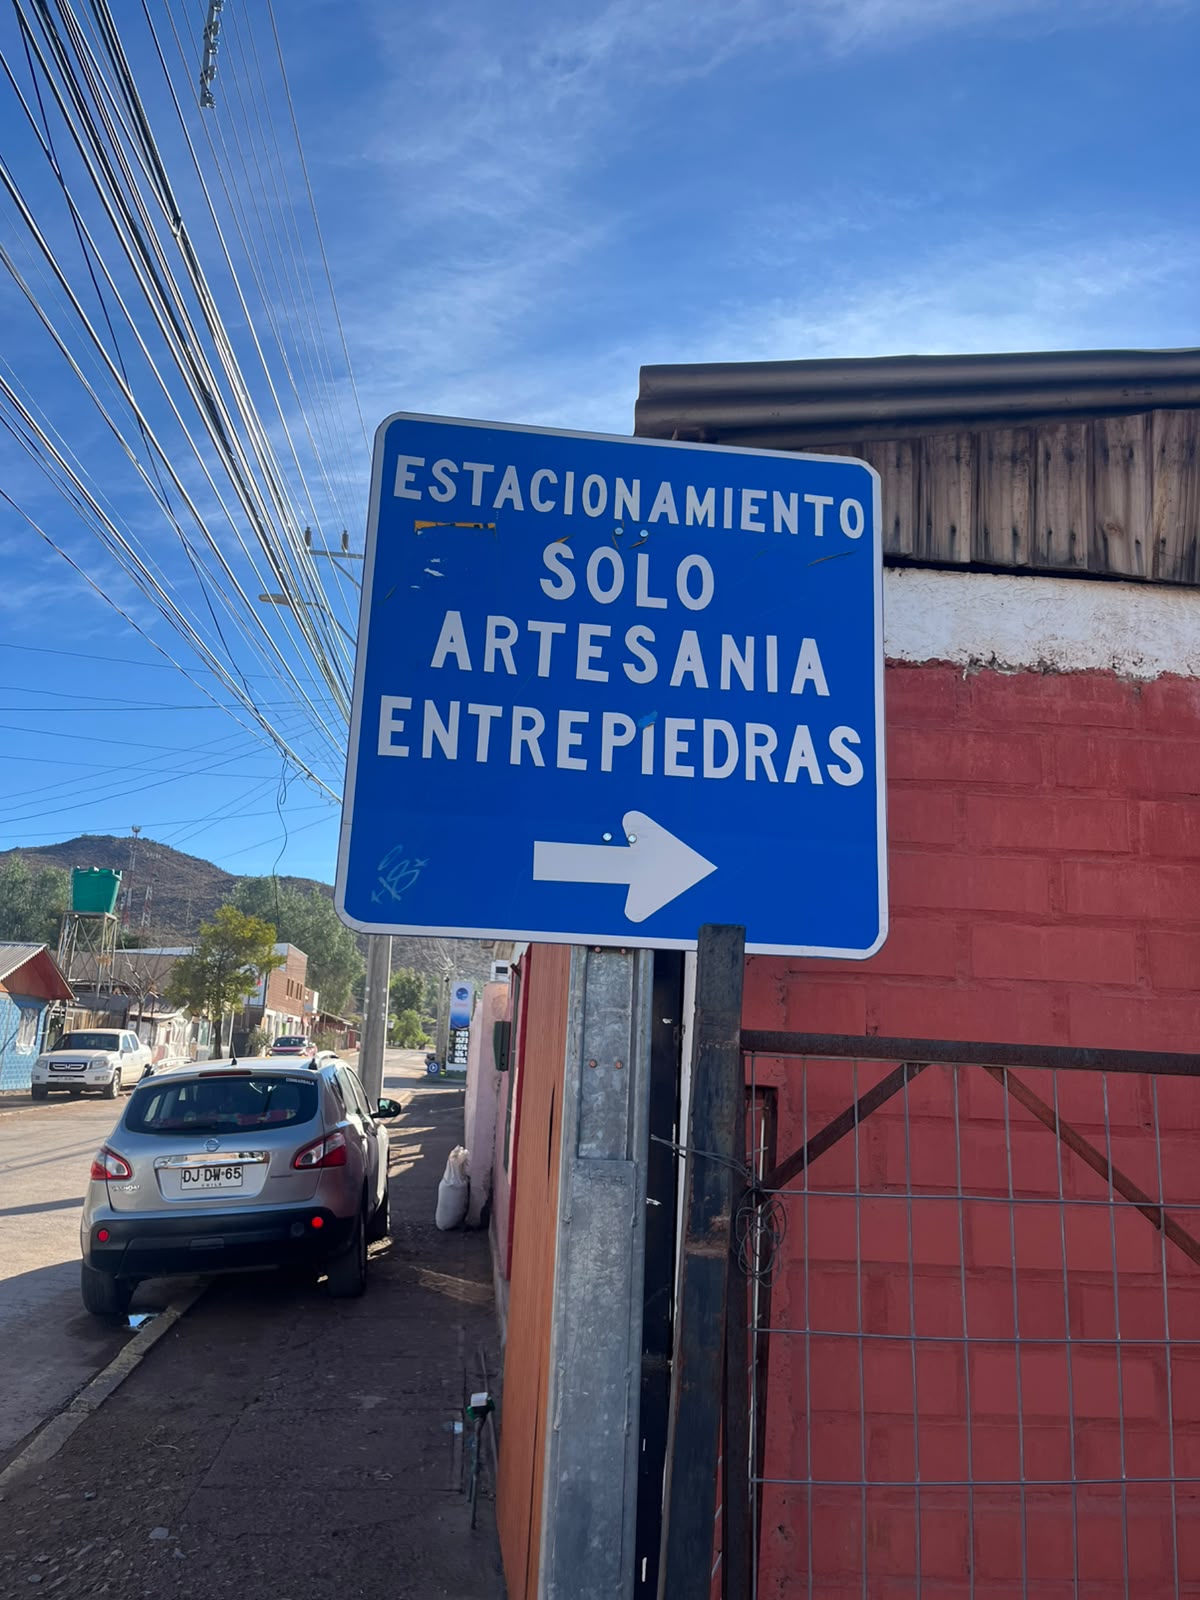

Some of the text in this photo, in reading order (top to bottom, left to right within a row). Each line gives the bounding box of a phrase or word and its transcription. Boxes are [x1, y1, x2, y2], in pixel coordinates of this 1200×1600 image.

[393, 454, 865, 539] ESTACIONAMIENTO
[539, 541, 714, 611] SOLO
[430, 610, 830, 696] ARTESANIA
[377, 695, 864, 787] ENTREPIEDRAS
